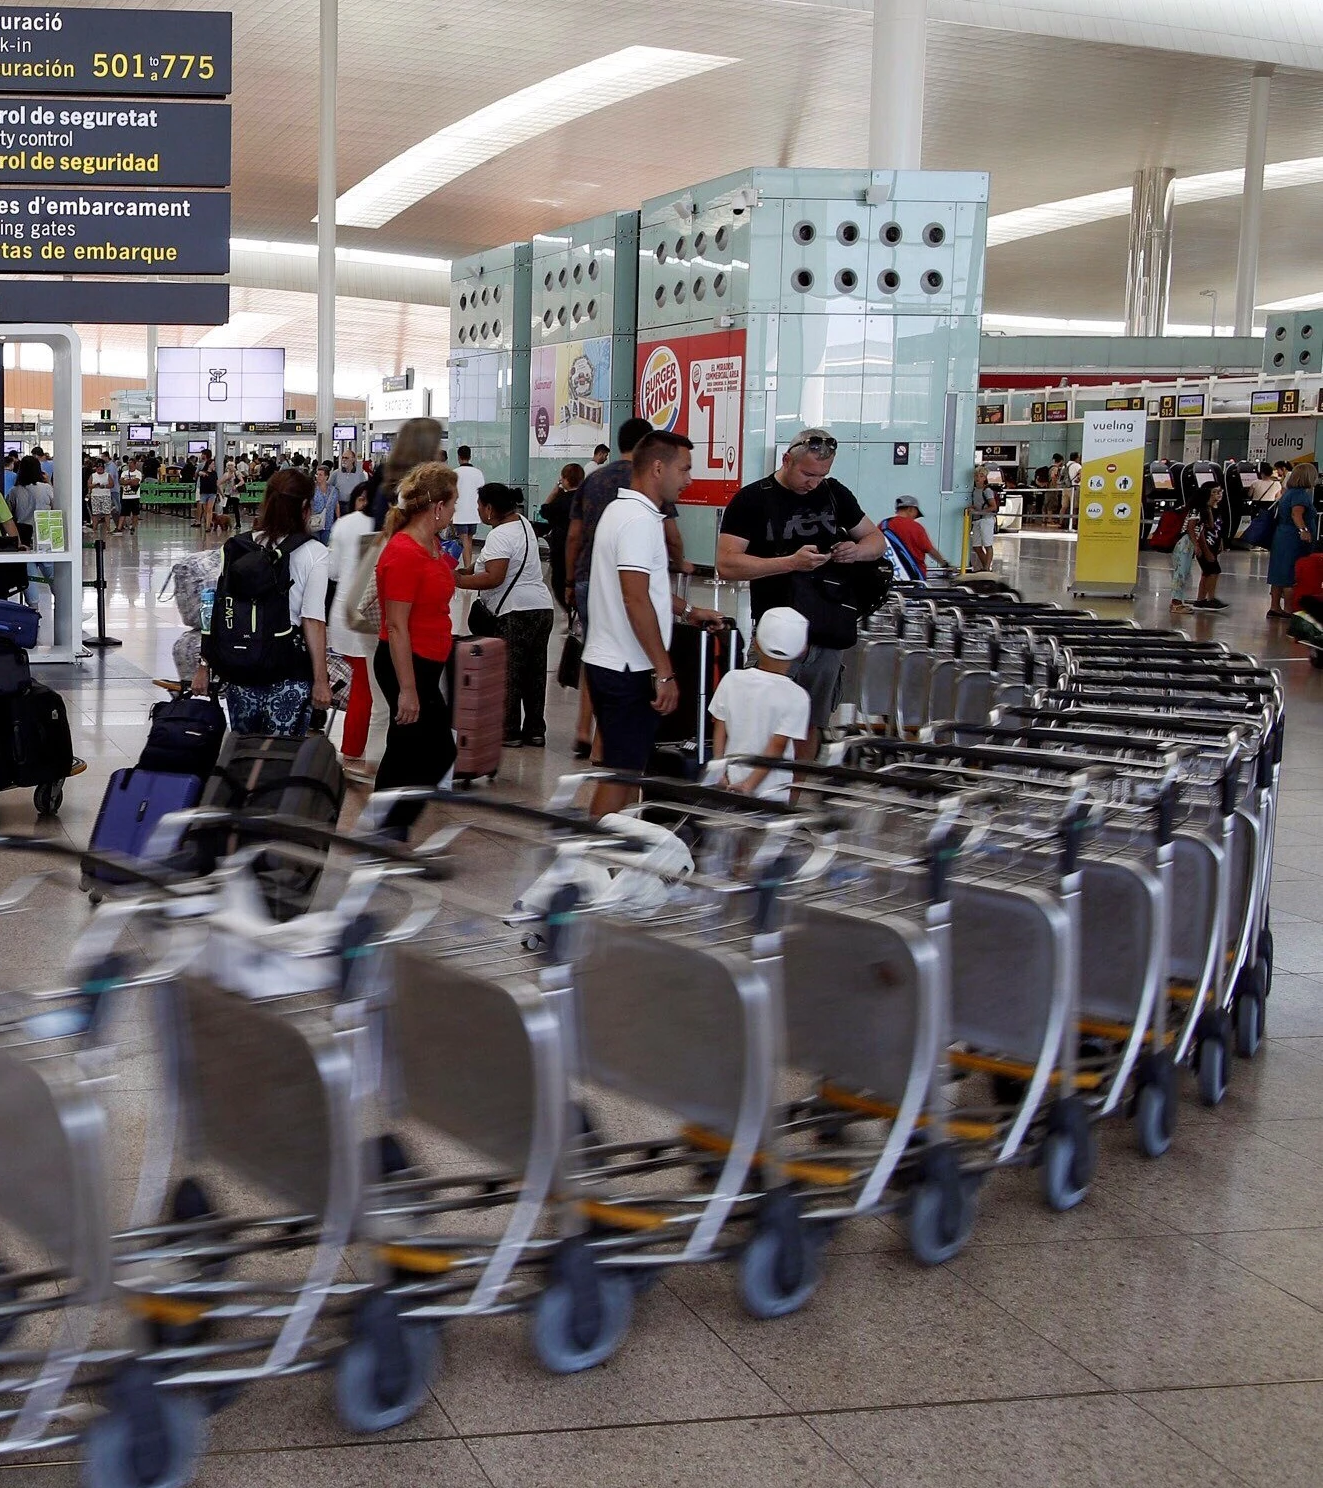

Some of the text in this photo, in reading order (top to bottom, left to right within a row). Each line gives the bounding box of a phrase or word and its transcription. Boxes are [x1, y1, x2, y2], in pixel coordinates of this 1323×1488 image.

[93, 54, 213, 79] 501 to 775
[151, 72, 157, 81] a
[31, 106, 54, 124] de
[60, 110, 157, 129] seguretat
[19, 131, 72, 146] control
[31, 152, 54, 169] de
[60, 153, 158, 174] seguridad
[28, 197, 190, 216] d'embarcament
[31, 221, 75, 238] gates
[41, 242, 65, 259] de
[74, 242, 177, 264] embarque
[645, 362, 676, 398] BURGER
[705, 372, 728, 380] COMMERCIAL
[646, 378, 678, 420] KING
[1282, 404, 1295, 412] 511
[1162, 408, 1173, 416] 512
[1093, 420, 1134, 432] vueling
[225, 596, 233, 629] CMP
